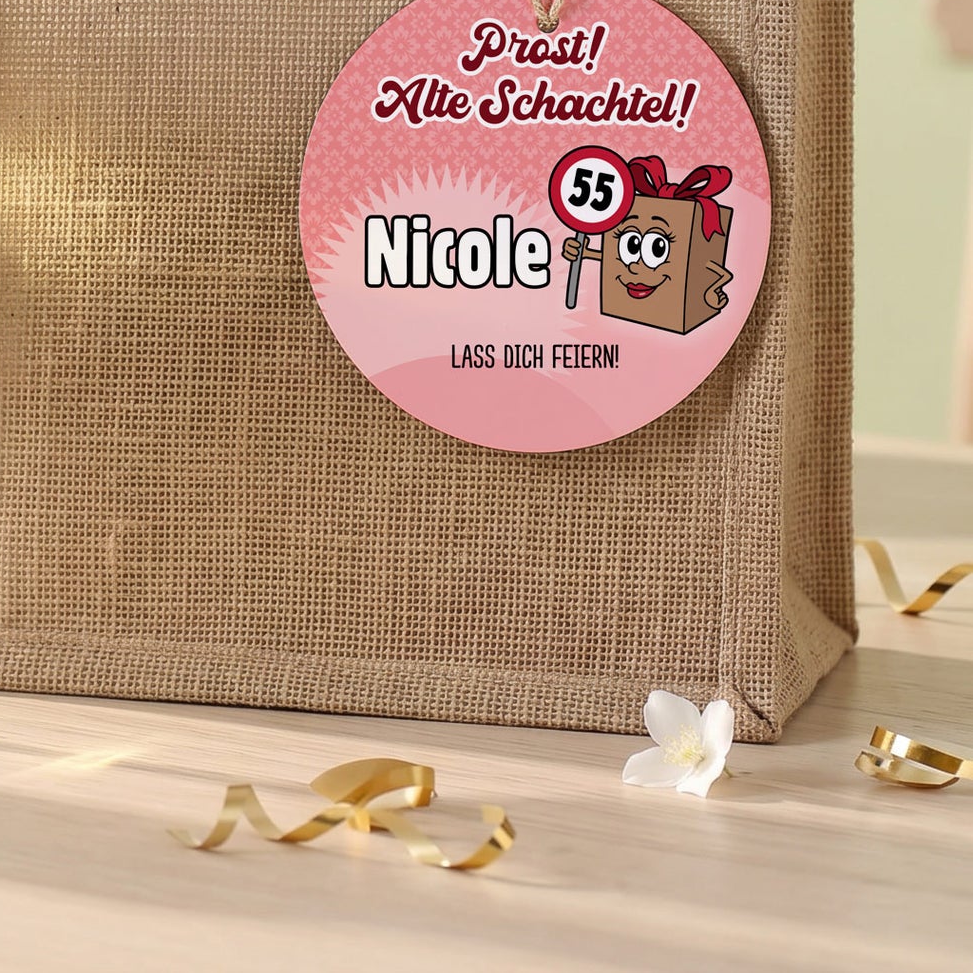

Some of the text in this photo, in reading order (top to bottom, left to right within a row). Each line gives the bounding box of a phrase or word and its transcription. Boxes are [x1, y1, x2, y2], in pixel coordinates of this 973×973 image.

[460, 20, 607, 72] Prost!
[374, 77, 697, 129] Alte Schachtel!
[567, 167, 616, 212] 55
[364, 214, 552, 290] Nicole
[450, 343, 620, 369] LASS DICH FEIERN!
